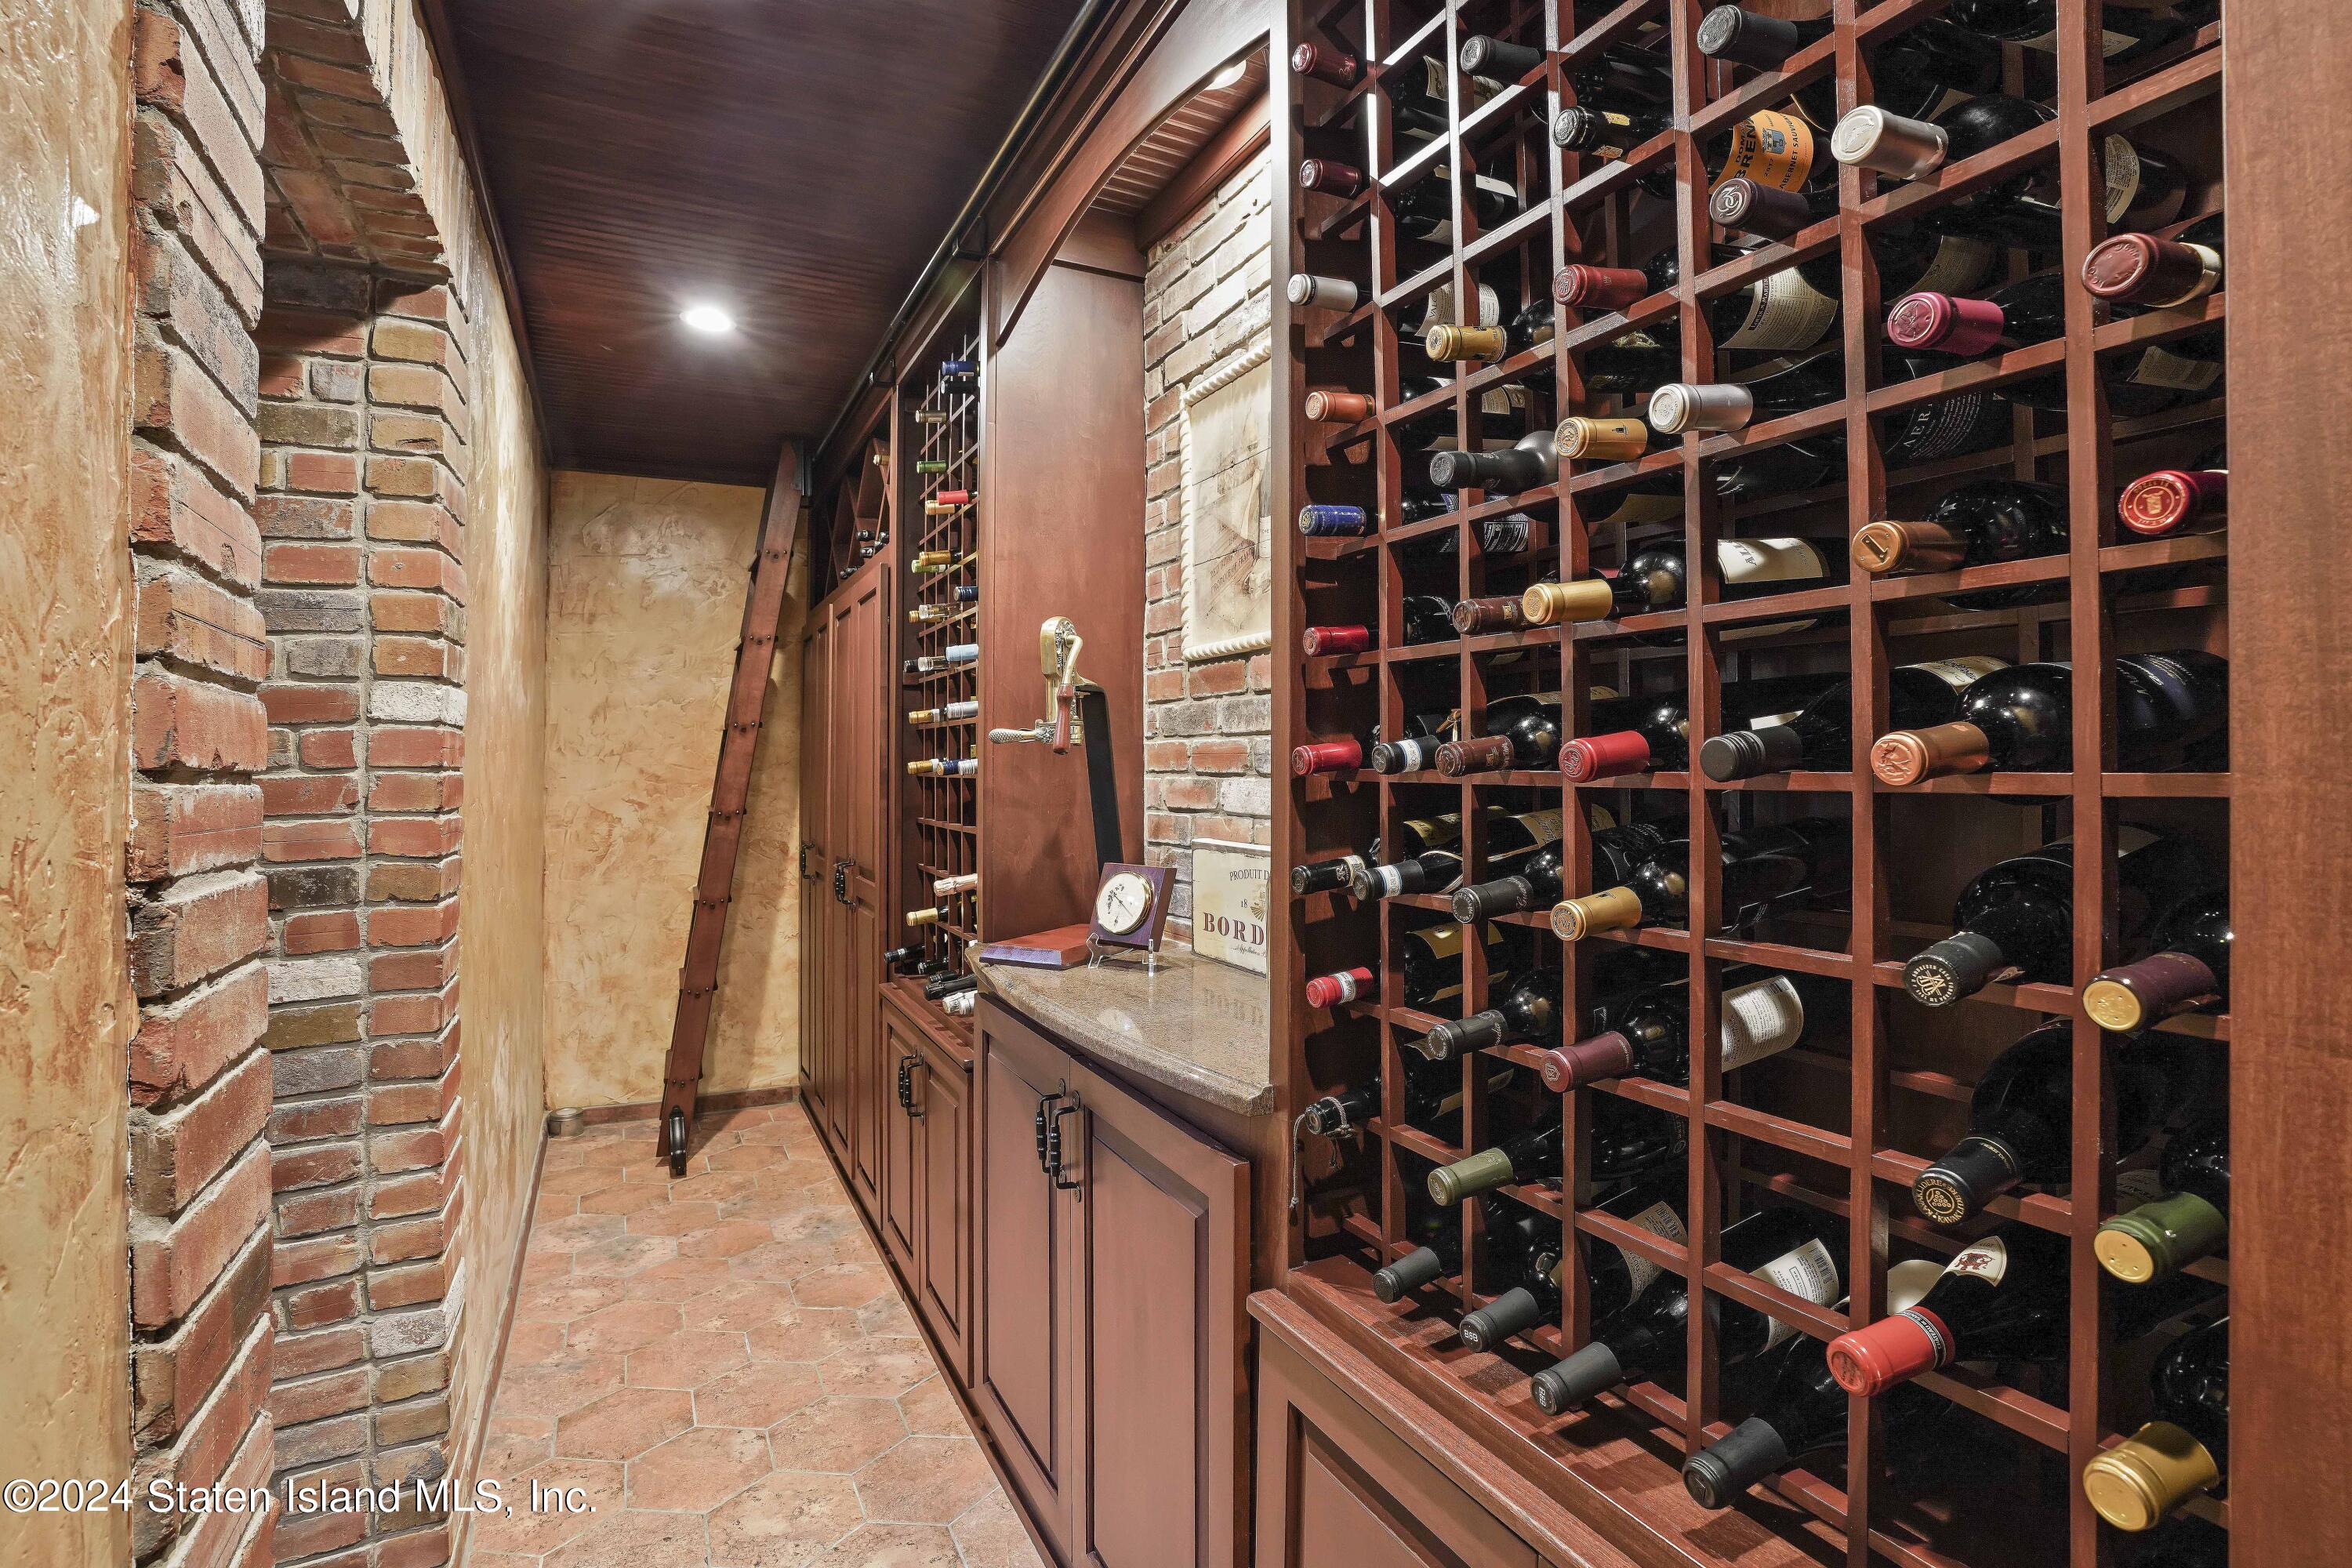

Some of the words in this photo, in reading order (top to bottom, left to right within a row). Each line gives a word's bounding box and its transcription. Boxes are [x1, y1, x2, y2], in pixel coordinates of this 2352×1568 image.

[1779, 151, 1798, 189] ABERNET
[1229, 869, 1262, 881] PRODUIT
[1241, 898, 1248, 909] 18
[1203, 912, 1265, 946] BORD
